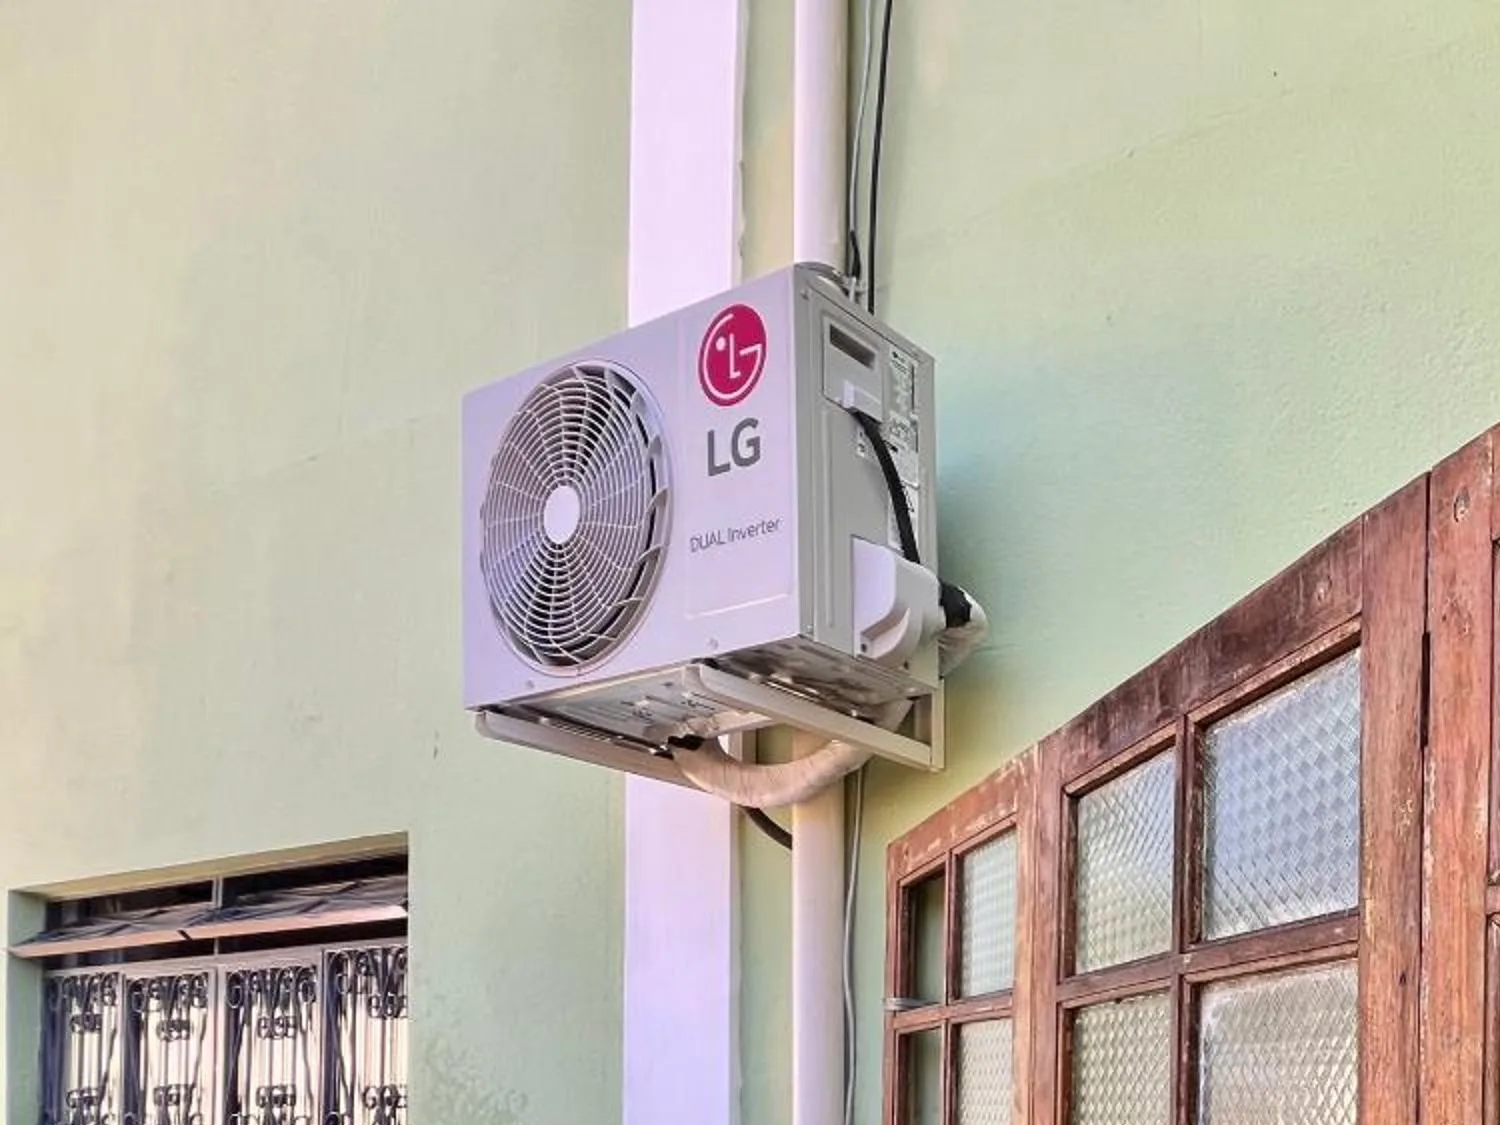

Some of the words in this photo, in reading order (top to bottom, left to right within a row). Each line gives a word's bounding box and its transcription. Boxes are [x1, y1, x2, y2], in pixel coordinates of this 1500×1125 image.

[707, 417, 762, 477] LG
[690, 530, 726, 553] DUAL
[727, 519, 780, 542] Inverter
